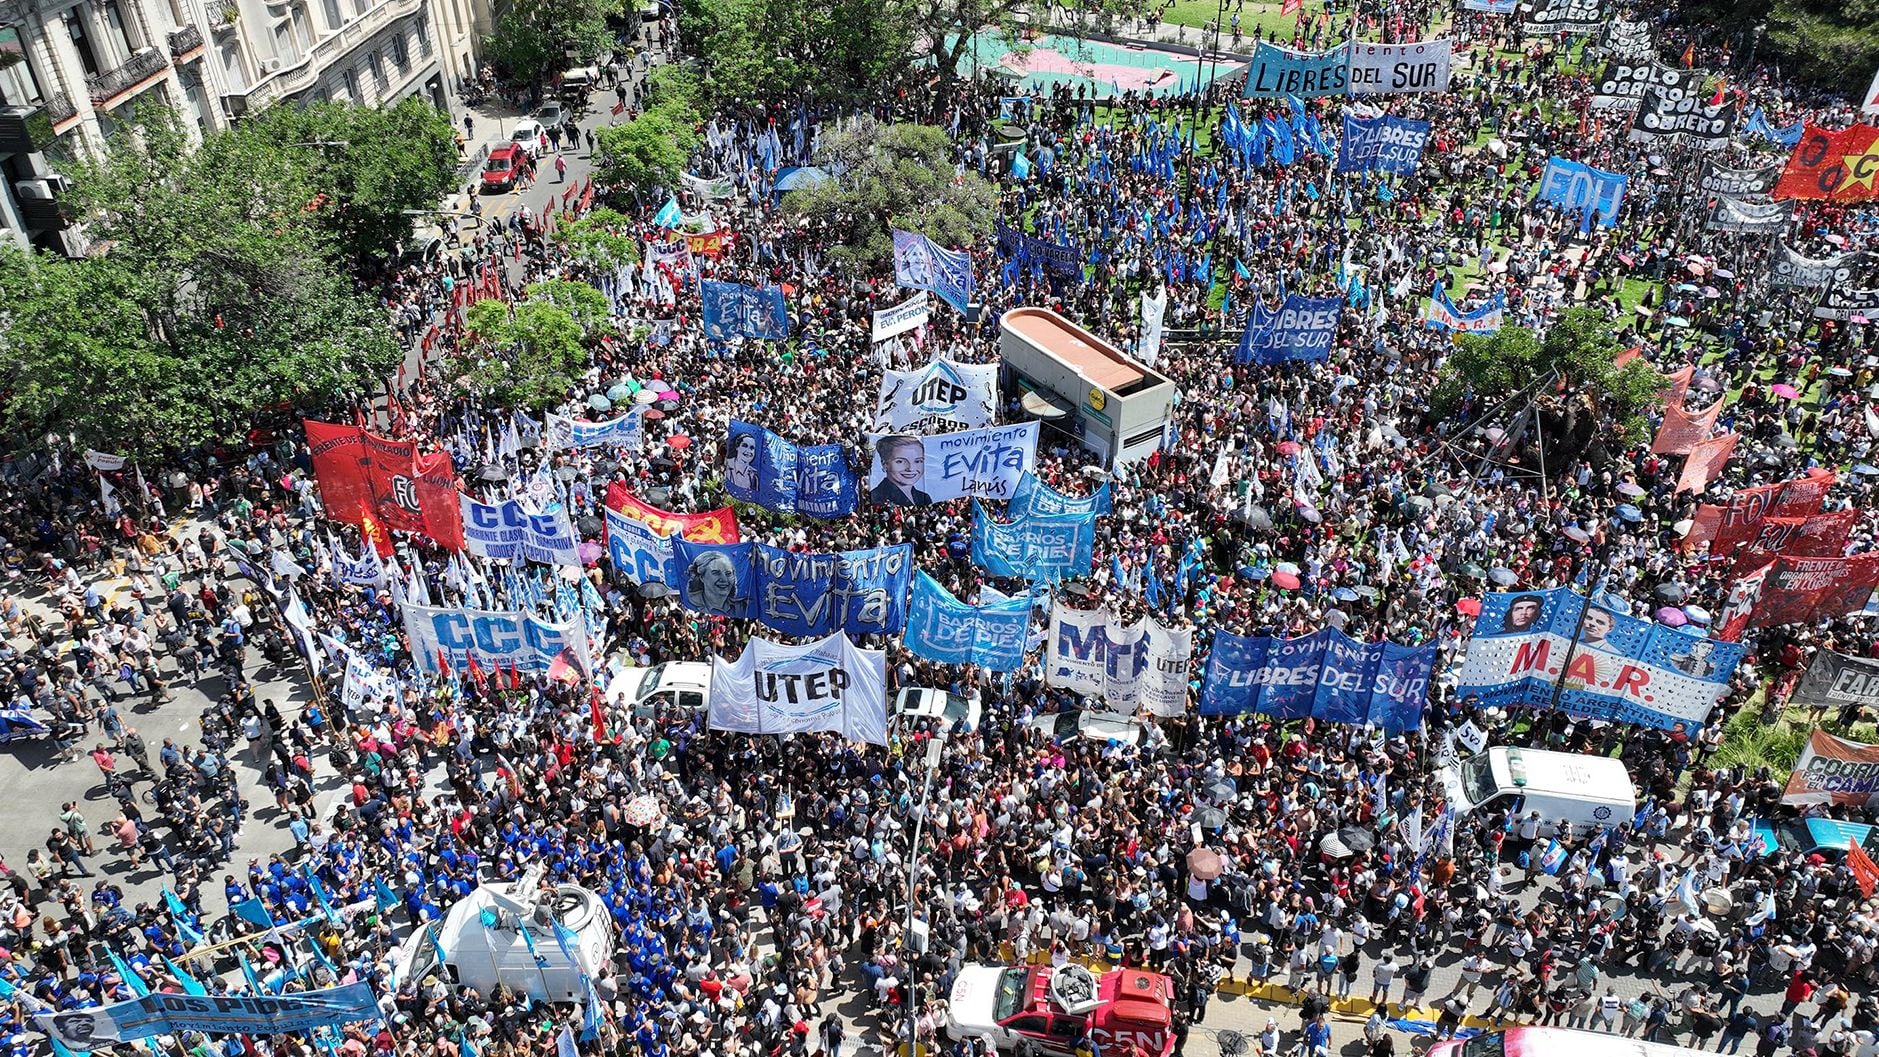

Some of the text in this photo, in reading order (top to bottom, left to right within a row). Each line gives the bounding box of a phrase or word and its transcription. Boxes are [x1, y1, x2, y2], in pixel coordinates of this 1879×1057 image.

[1534, 8, 1600, 22] OBRERO
[1351, 67, 1382, 84] DEL
[1392, 62, 1437, 89] SUR
[1615, 65, 1680, 86] POLO
[1657, 97, 1722, 119] POLO
[1643, 113, 1726, 135] OBRERO
[1388, 147, 1419, 164] SUR
[1701, 176, 1765, 193] OBRERO
[1296, 331, 1332, 349] SUR
[911, 376, 968, 407] UTEP
[939, 426, 1028, 451] movimiento
[942, 444, 1024, 481] Evita
[961, 476, 1007, 497] Lanús
[471, 499, 558, 537] CCC
[1795, 560, 1836, 572] FRENTE
[1785, 579, 1804, 590] EN
[764, 580, 889, 630] Evita
[936, 625, 1019, 649] DE PIE
[1267, 640, 1381, 663] MOVIMIENTO
[754, 666, 852, 705] UTEP
[1229, 663, 1427, 699] LIBRES DEL SUR
[1576, 696, 1666, 727] ARGENTINA
[1093, 1028, 1164, 1051] C5N
